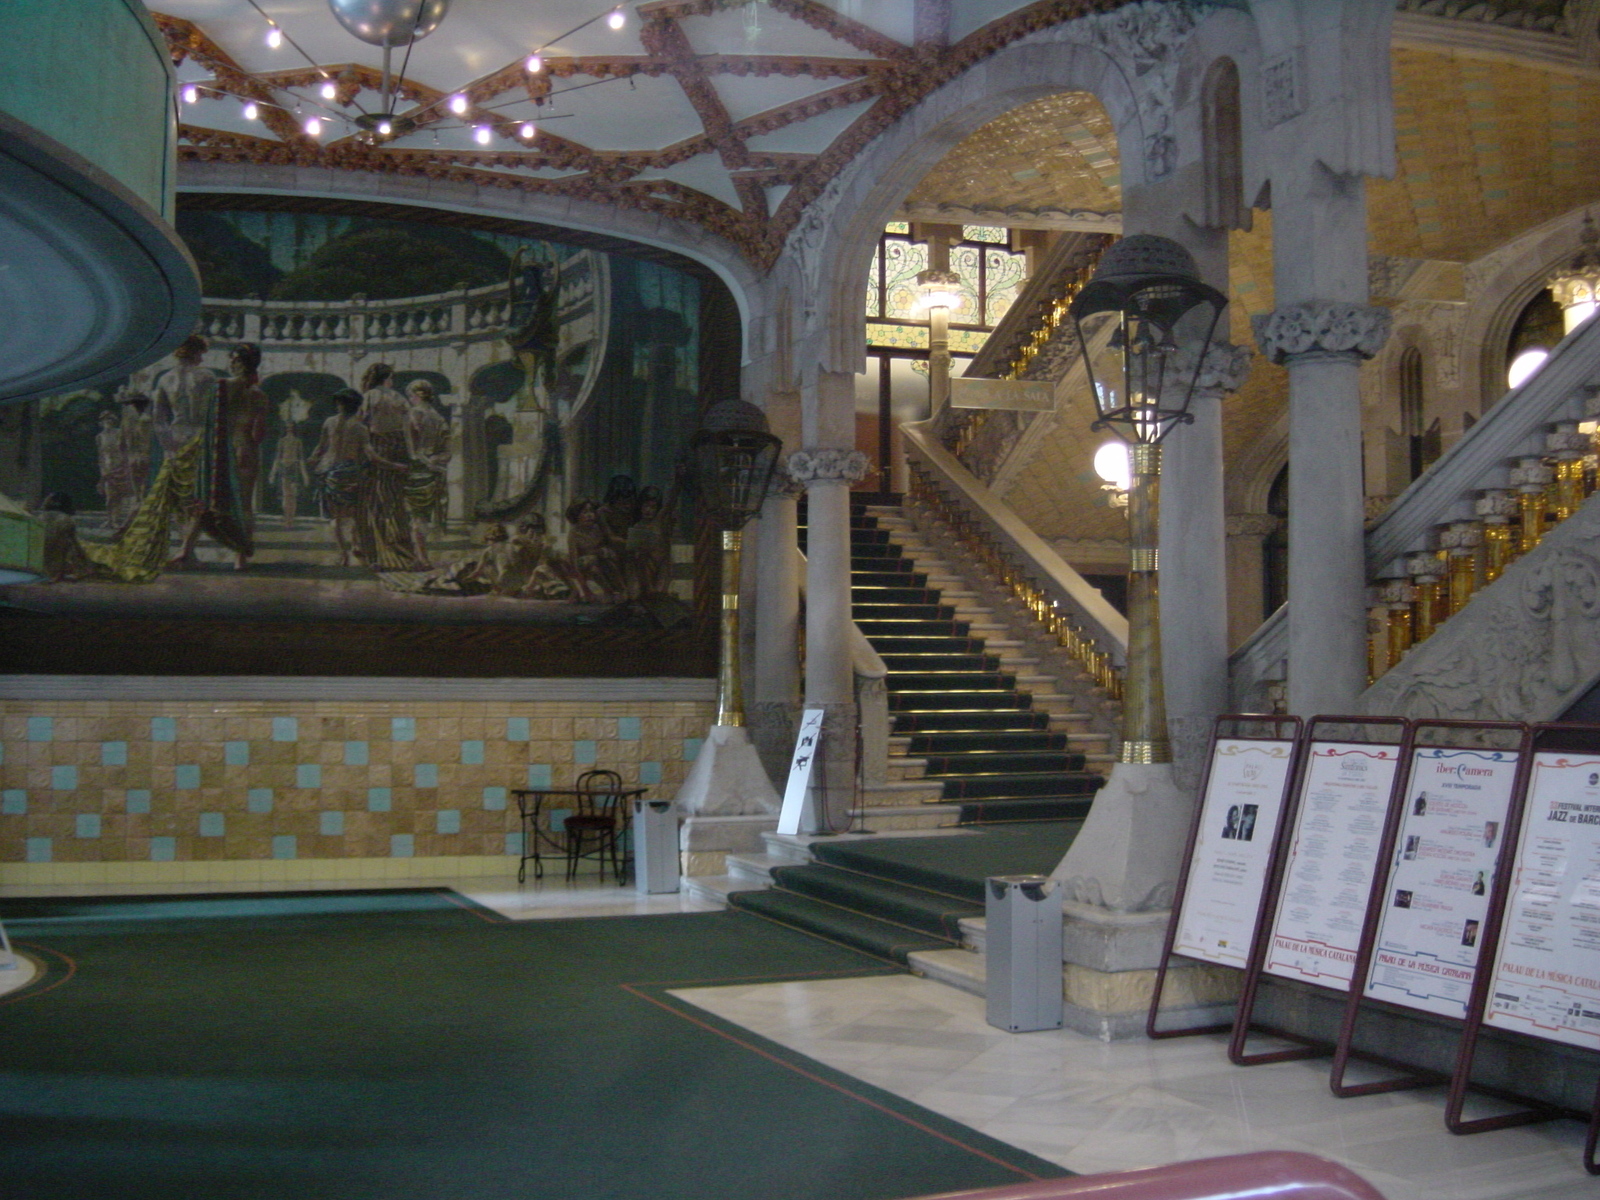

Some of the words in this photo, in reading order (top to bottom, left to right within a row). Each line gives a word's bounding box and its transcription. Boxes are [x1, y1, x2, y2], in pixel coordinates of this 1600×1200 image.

[1023, 390, 1050, 403] SALA
[1547, 810, 1569, 822] JAZZ
[1275, 939, 1291, 950] PALAU
[1291, 943, 1300, 951] DE
[1299, 944, 1307, 953] LA
[1378, 953, 1396, 964] PALAU
[1397, 957, 1406, 966] DE
[1408, 959, 1416, 969] LA
[1441, 967, 1472, 980] CATALANA
[1502, 963, 1523, 975] PALAU
[1524, 966, 1535, 977] DE
[1535, 968, 1545, 980] LA
